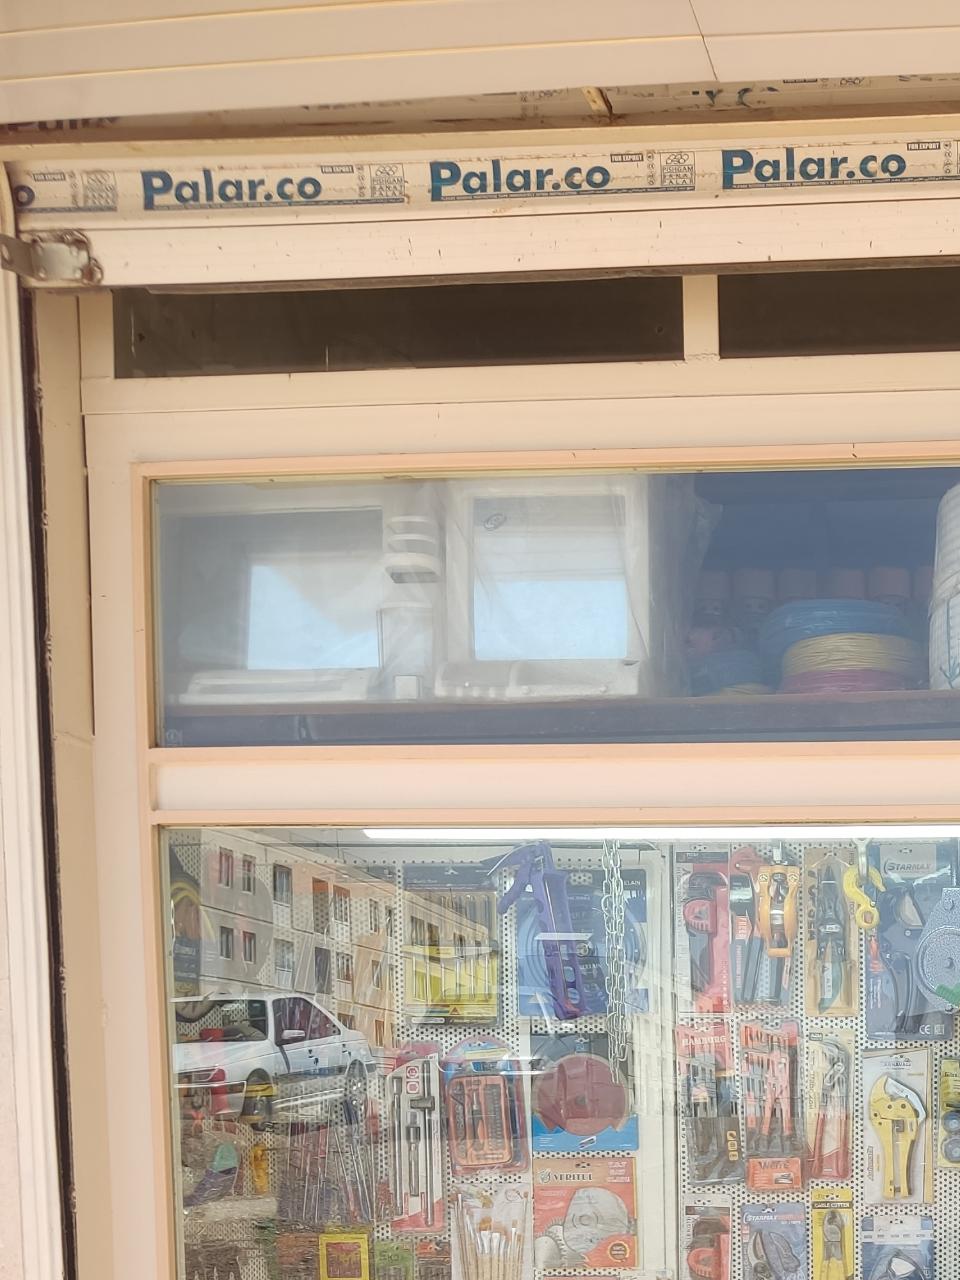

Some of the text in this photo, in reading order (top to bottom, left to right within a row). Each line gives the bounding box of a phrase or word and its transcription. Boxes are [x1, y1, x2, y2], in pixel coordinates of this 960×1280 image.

[140, 168, 322, 210] Palar.co
[429, 159, 610, 202] Palar.co
[721, 146, 907, 191] Palar.co
